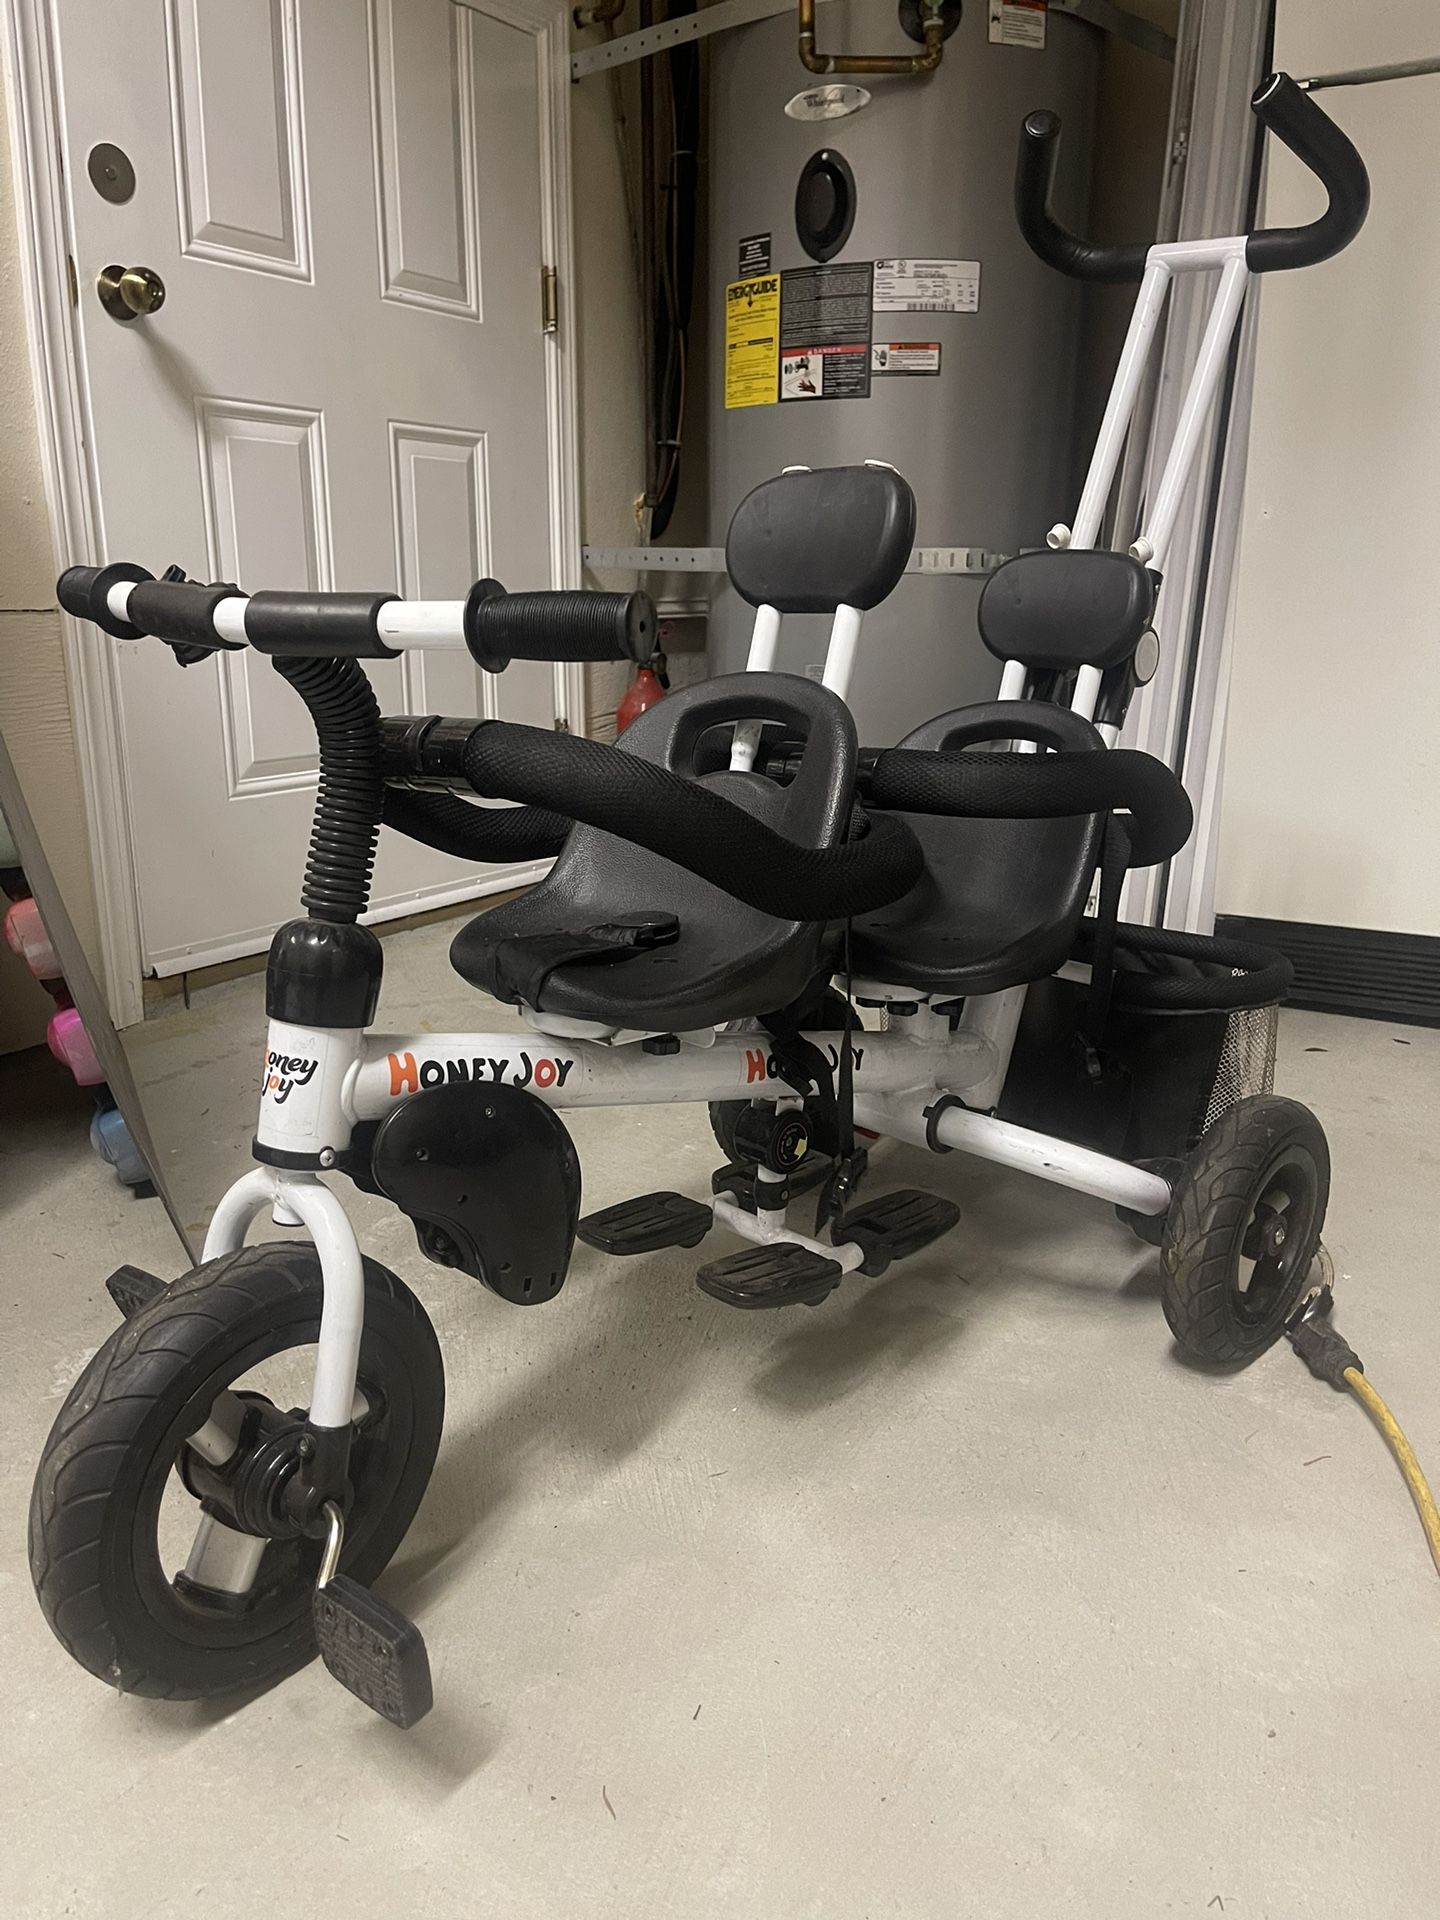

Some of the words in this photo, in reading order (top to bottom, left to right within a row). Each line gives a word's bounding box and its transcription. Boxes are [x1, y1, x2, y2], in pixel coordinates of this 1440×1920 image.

[265, 1049, 319, 1085] oney
[513, 1051, 574, 1089] JOY
[827, 1044, 864, 1071] JY
[262, 1067, 294, 1104] joy
